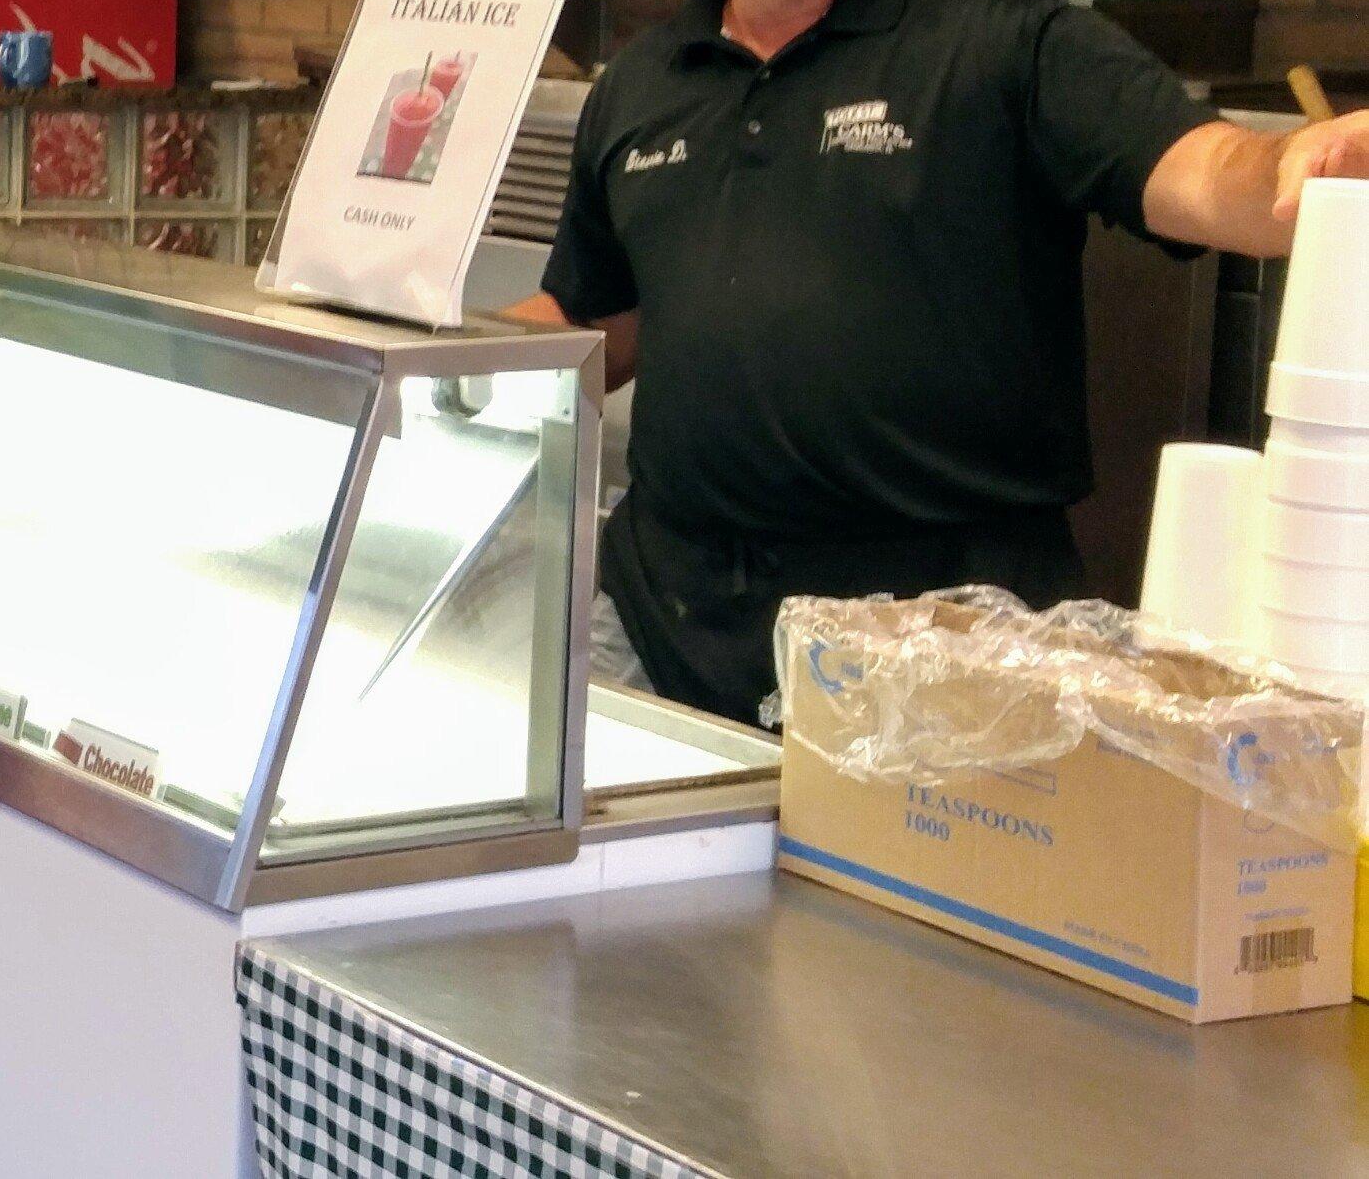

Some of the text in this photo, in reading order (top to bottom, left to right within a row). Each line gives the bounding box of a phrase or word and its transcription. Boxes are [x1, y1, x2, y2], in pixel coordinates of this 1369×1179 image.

[482, 2, 521, 27] ICE
[344, 205, 417, 232] CASH ONLY
[84, 745, 154, 797] Chocolate
[905, 810, 950, 841] 1000
[906, 782, 1054, 846] TEASPOONS
